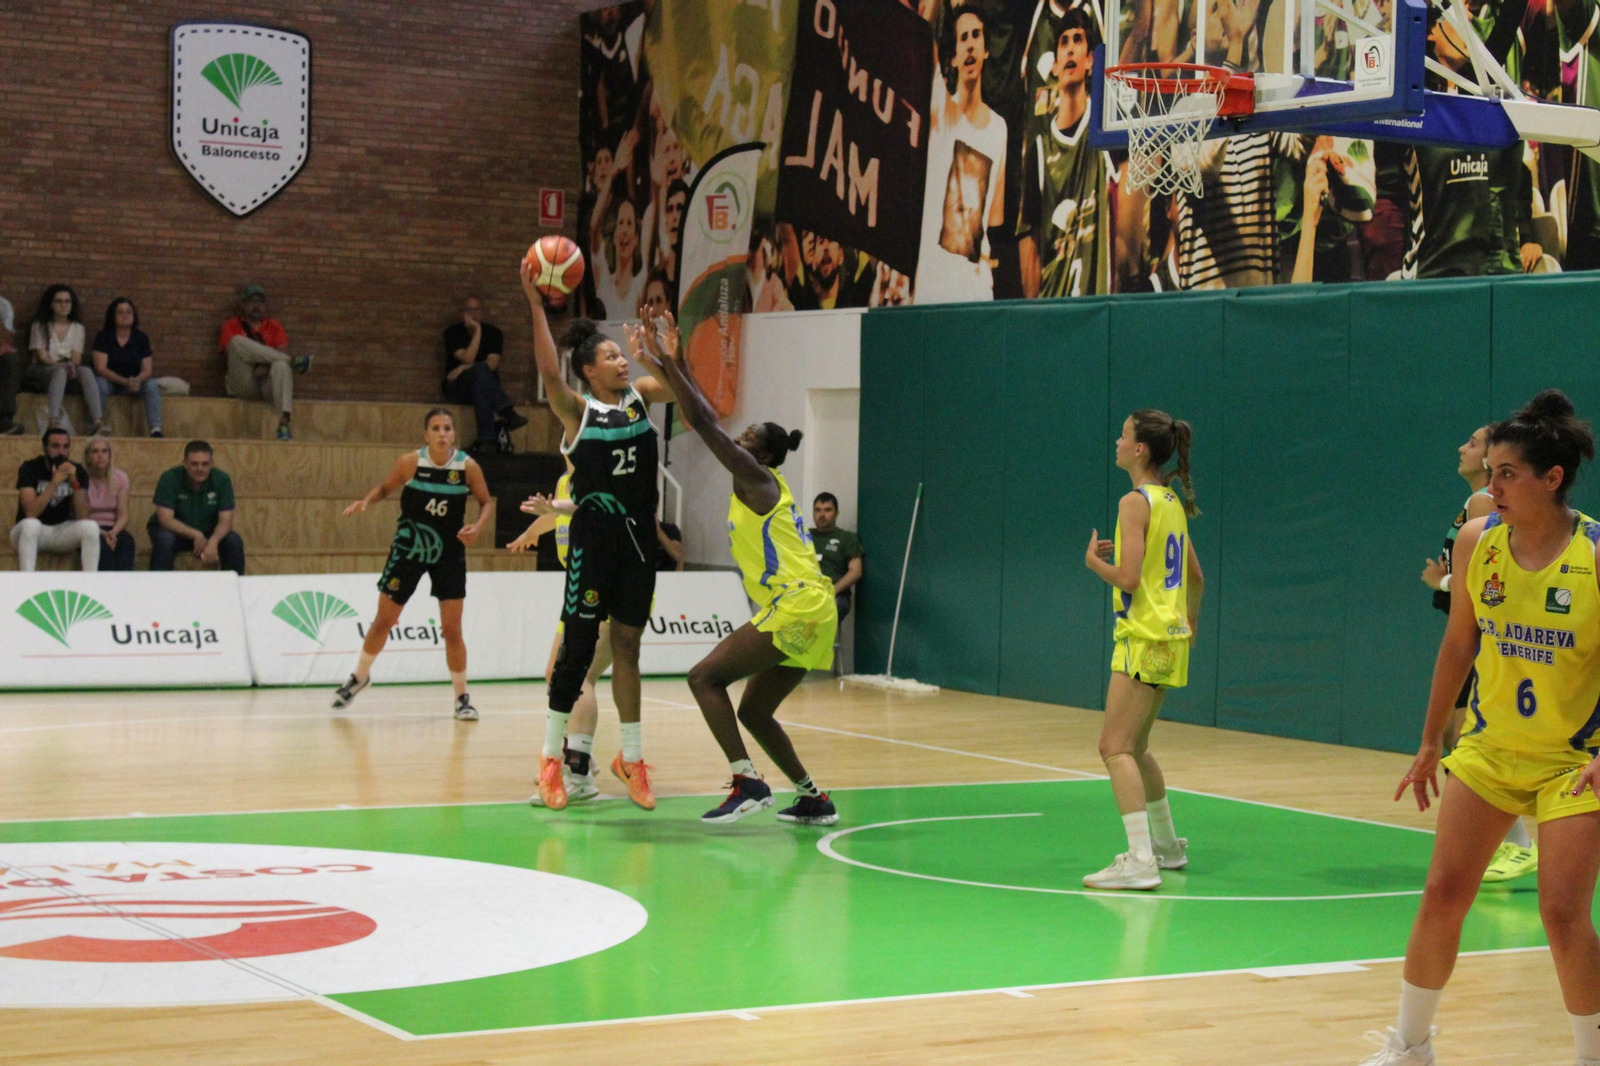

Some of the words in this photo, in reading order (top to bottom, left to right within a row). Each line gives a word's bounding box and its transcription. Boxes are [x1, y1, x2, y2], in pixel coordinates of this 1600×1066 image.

[202, 117, 279, 143] Unicaja
[202, 145, 280, 160] Baloncesto
[1450, 153, 1488, 177] Unicaja
[612, 446, 637, 475] 25
[425, 498, 448, 517] 46
[1164, 531, 1184, 590] 91
[110, 621, 219, 649] Unicaja
[649, 614, 734, 639] Unicaja
[1503, 622, 1576, 649] ADAREVA
[1516, 677, 1537, 718] 6
[0, 859, 196, 876] MAL
[86, 863, 374, 883] COSTA
[0, 877, 74, 890] D
